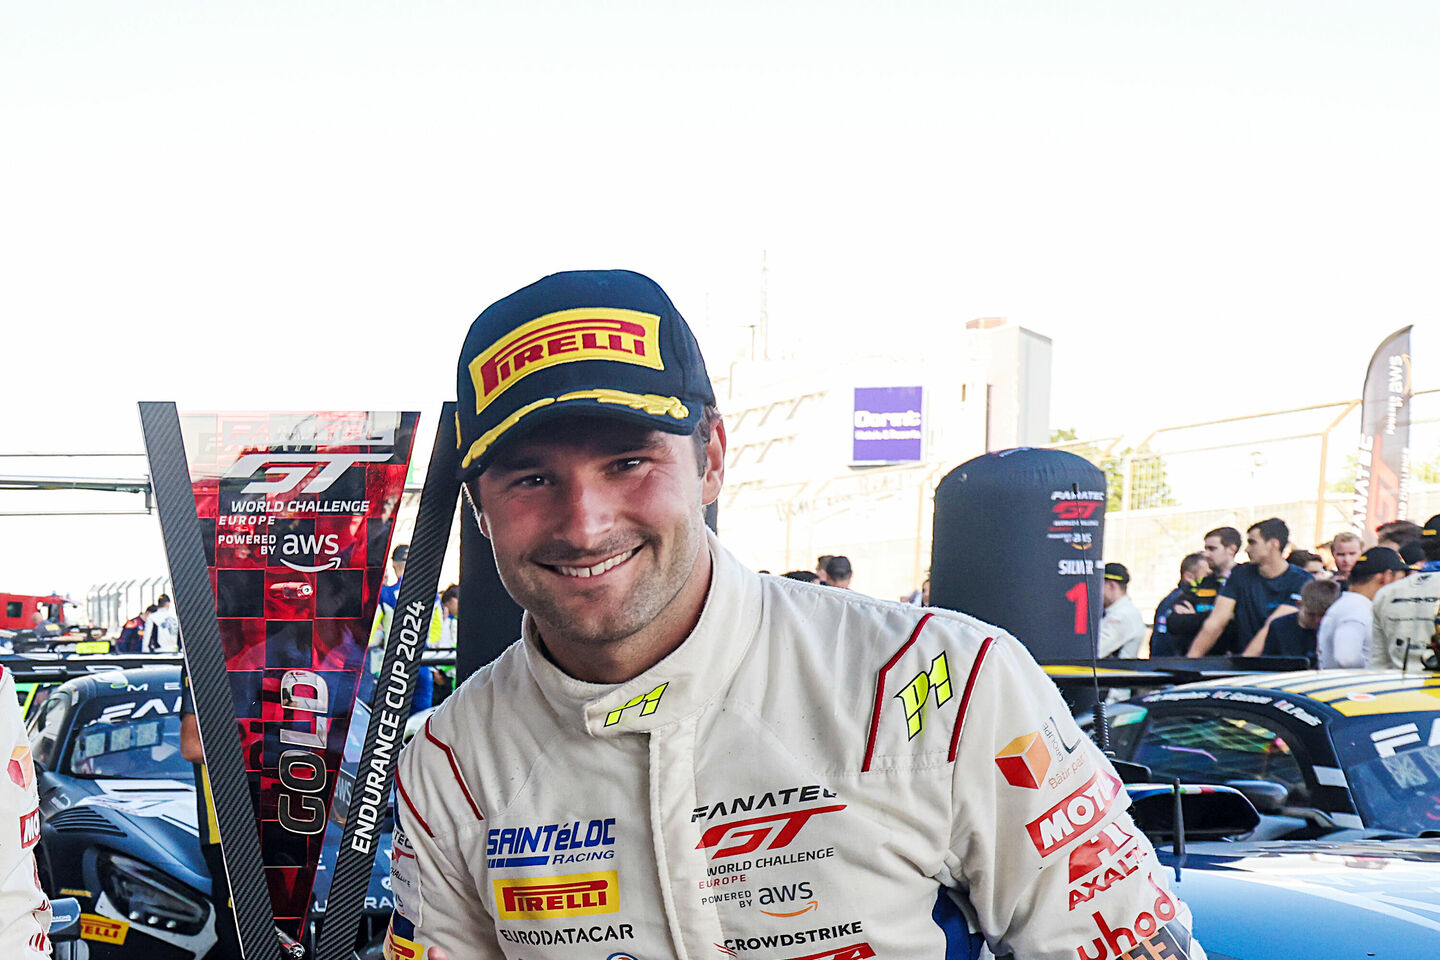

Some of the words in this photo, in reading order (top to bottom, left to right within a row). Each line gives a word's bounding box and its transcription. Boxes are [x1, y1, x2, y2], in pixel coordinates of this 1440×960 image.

[480, 318, 646, 398] PIRELLI
[231, 500, 284, 513] WORLD
[287, 500, 370, 513] CHALLENGE
[218, 515, 276, 526] EUROPE
[218, 534, 277, 545] POWERED
[261, 545, 277, 555] BY
[282, 533, 340, 555] aws
[1065, 582, 1089, 635] 1
[397, 600, 426, 662] 2024
[385, 662, 411, 710] CUP
[277, 669, 329, 835] GOLD
[351, 711, 401, 855] ENDURANCE
[551, 849, 615, 866] RACING
[706, 860, 752, 877] WORLD
[755, 847, 835, 868] CHALLENGE
[698, 873, 747, 890] EUROPE
[758, 881, 814, 905] aws
[502, 878, 609, 913] PIRELLI
[701, 890, 752, 906] POWERED
[739, 899, 753, 909] BY
[499, 923, 635, 946] EURODATACAR
[723, 920, 864, 952] CROWDSTRIKE
